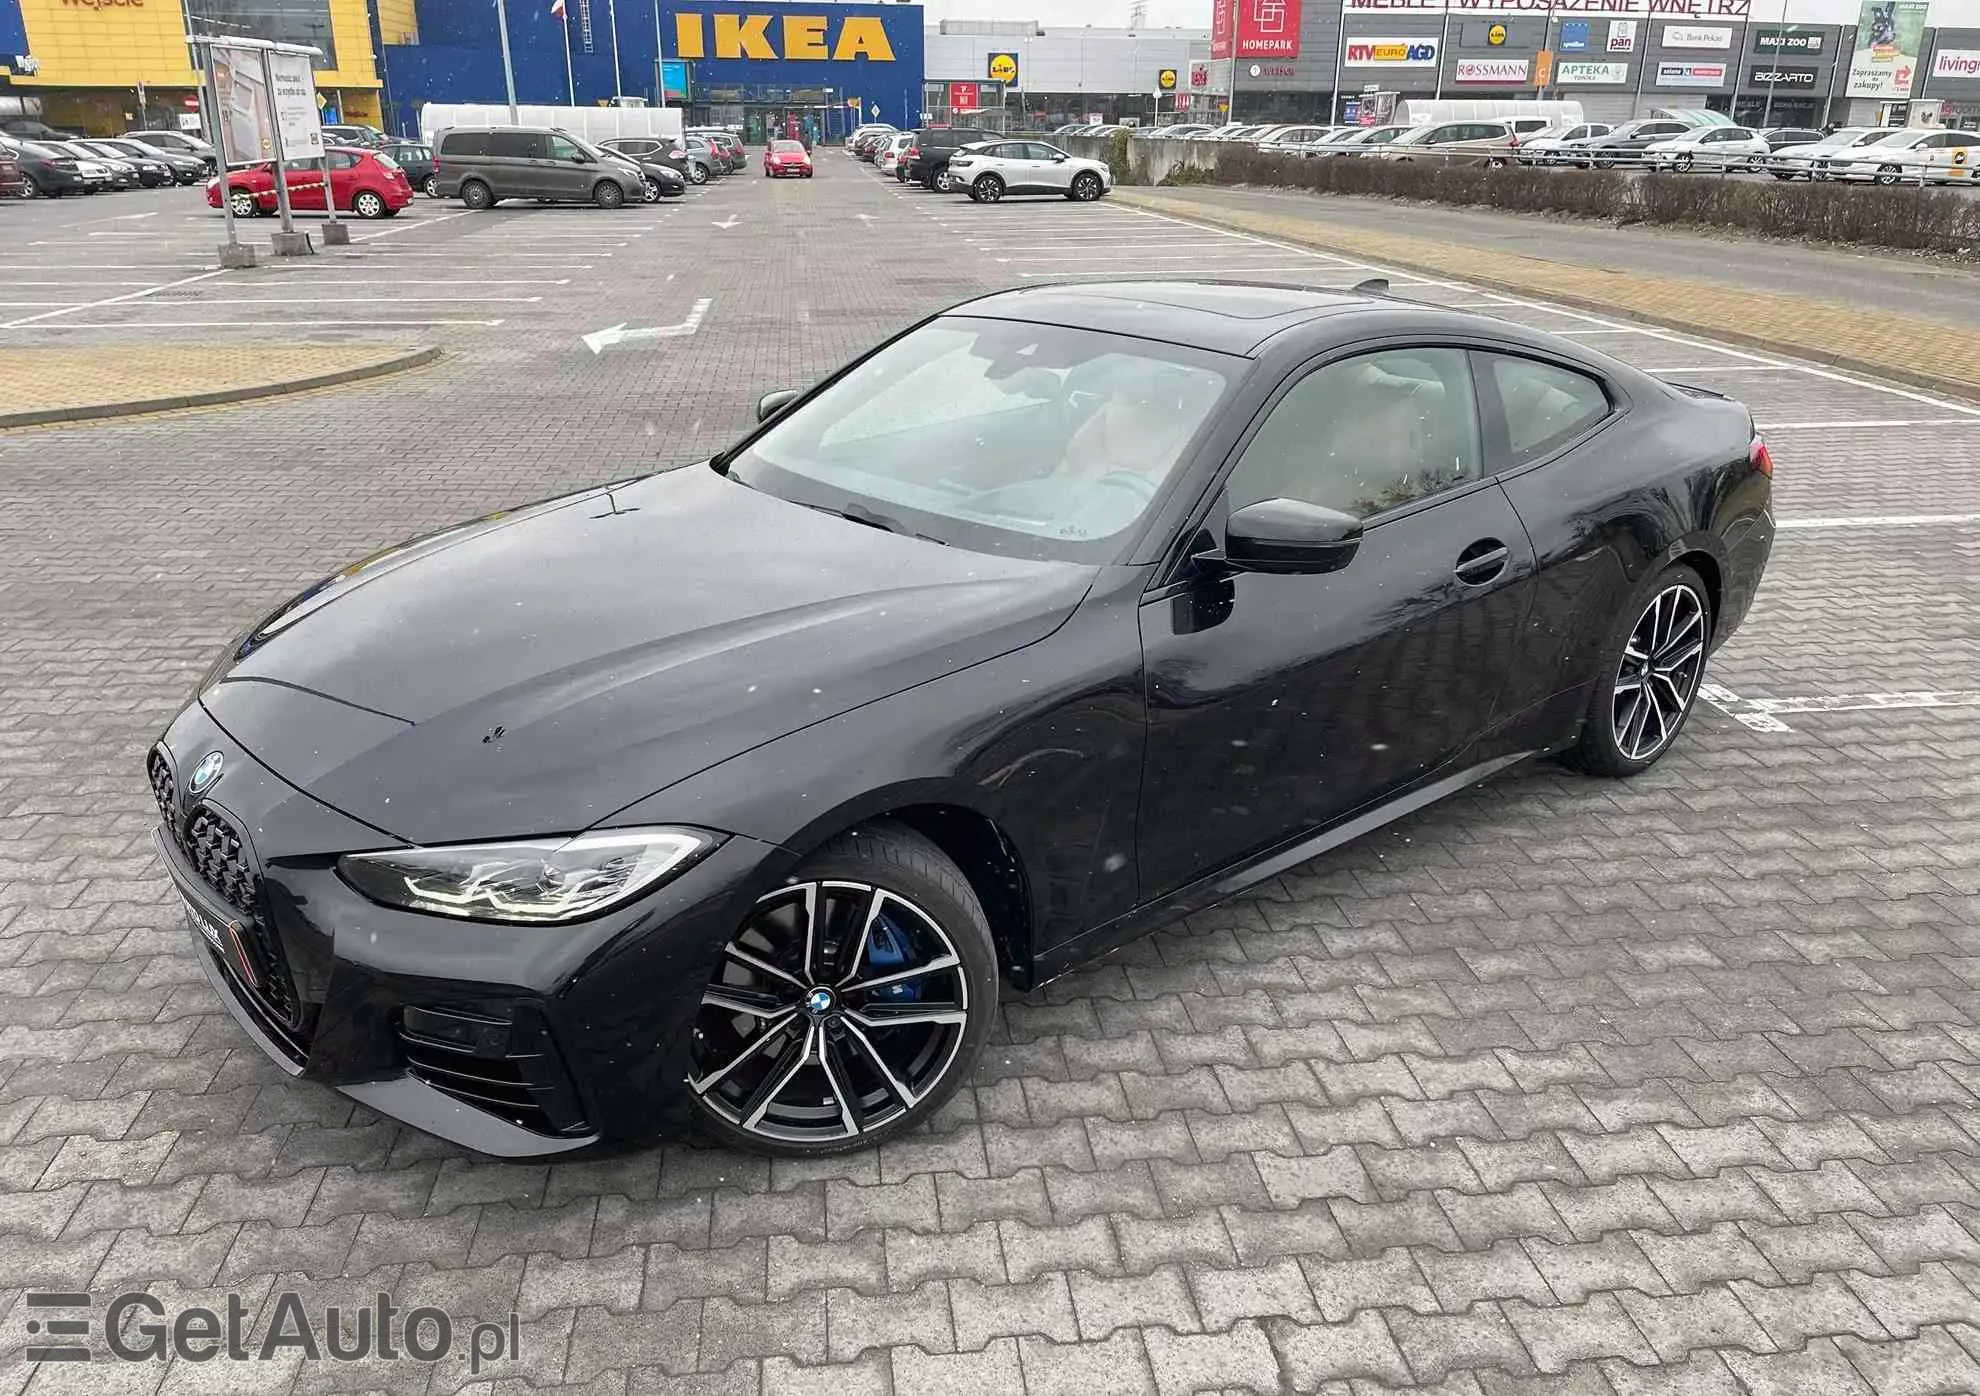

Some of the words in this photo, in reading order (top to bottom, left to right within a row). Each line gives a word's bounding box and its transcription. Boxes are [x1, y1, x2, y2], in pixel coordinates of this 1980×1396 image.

[675, 13, 896, 61] IKEA
[1787, 37, 1807, 47] ZOO
[1242, 39, 1293, 50] HOMEPARK
[1610, 38, 1631, 50] pan
[1348, 45, 1376, 60] RTV
[1376, 46, 1405, 58] EURO
[1407, 44, 1436, 60] AGD
[1458, 64, 1528, 76] ROSSMANN
[1561, 65, 1610, 75] APTEKA
[1853, 69, 1892, 79] Zapraszamy
[1754, 71, 1814, 83] BIZZARTO
[1853, 80, 1883, 91] zakupy!
